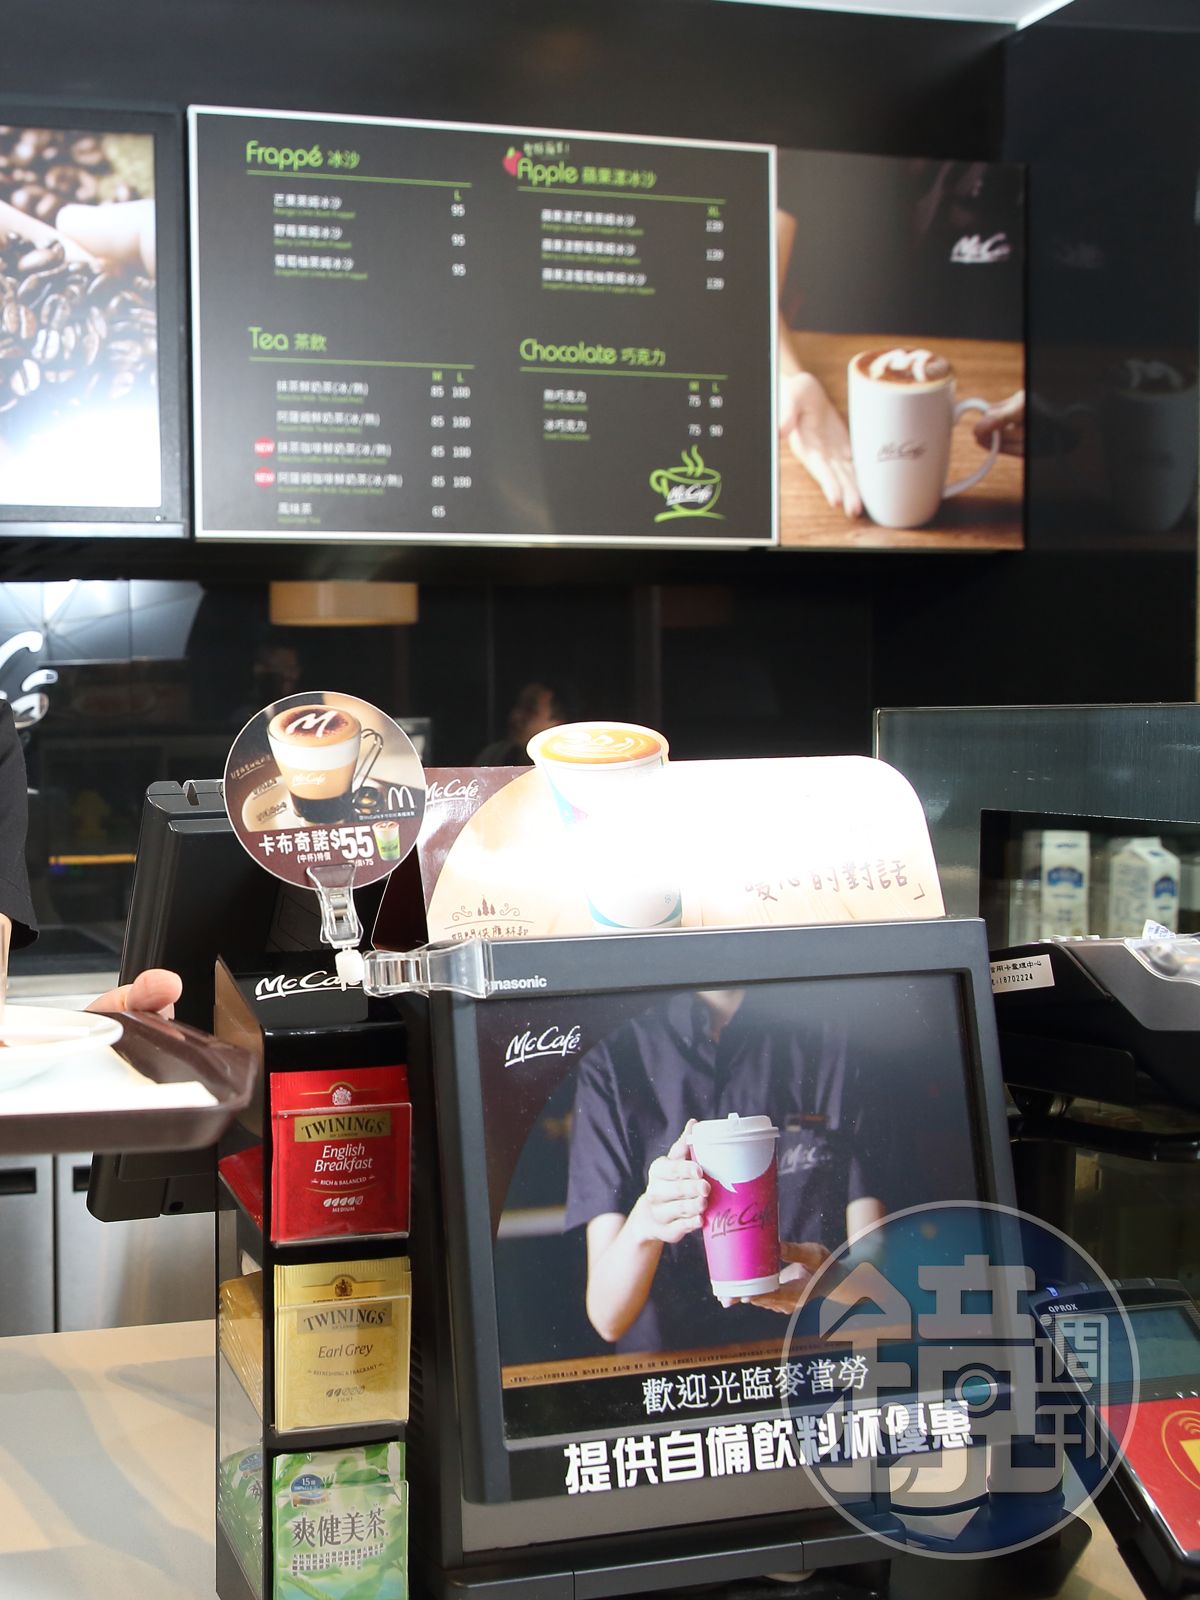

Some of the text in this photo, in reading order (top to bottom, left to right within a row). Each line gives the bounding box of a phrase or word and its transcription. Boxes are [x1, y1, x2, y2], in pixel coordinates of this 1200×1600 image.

[246, 140, 323, 171] Frappé
[517, 157, 579, 187] Apple
[248, 327, 289, 351] Tea
[519, 338, 667, 366] Chocolate 巧克力
[258, 830, 330, 856] 卡布奇諾
[255, 970, 362, 1001] McCa
[504, 1025, 582, 1068] McCafé
[301, 1116, 385, 1139] TWININGS
[314, 1156, 373, 1173] Breakfast
[322, 1143, 366, 1161] English
[339, 1176, 367, 1186] BALANCED
[304, 1307, 386, 1331] TWININGS
[1048, 1303, 1078, 1313] QPROX
[318, 1343, 374, 1359] Earl Grey
[642, 1355, 869, 1415] 歡迎光臨麥當勞
[564, 1398, 974, 1494] 提供自備飲料杯優惠
[291, 1507, 386, 1548] 爽健美茶
